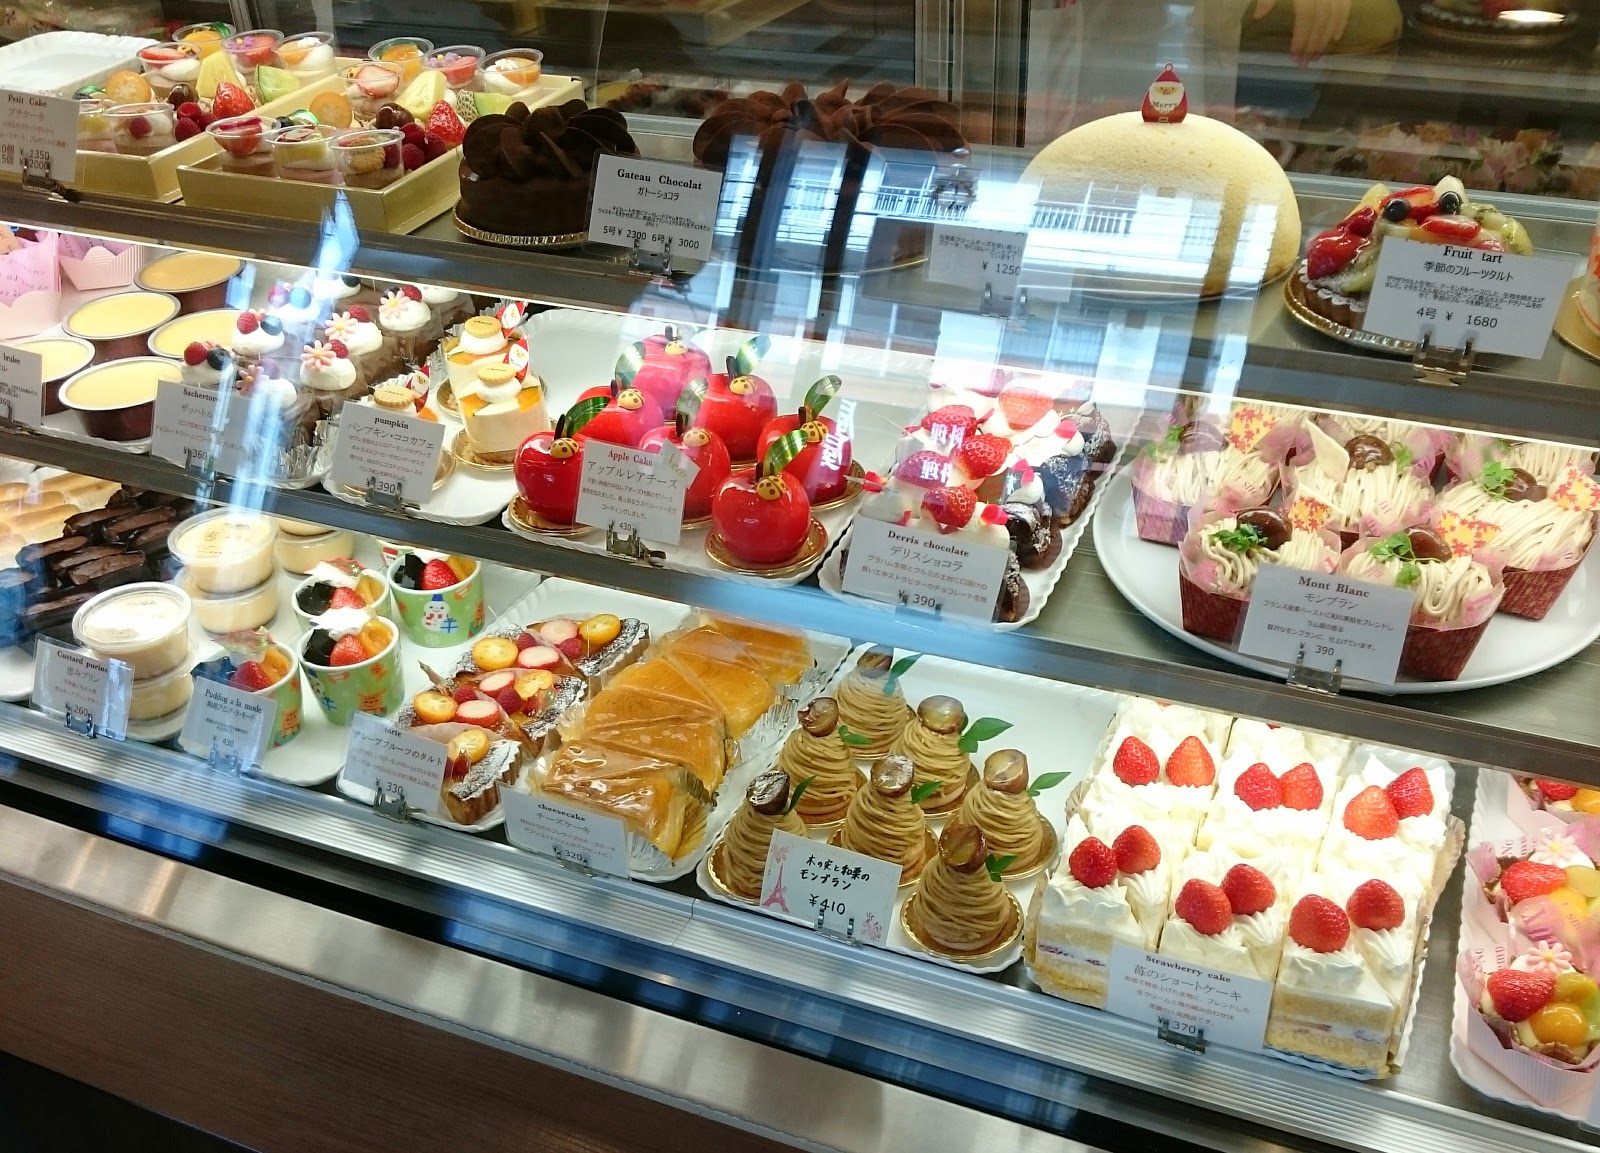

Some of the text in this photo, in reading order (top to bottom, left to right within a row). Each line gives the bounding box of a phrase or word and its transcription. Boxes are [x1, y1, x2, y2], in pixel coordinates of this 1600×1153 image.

[8, 94, 47, 107] Petit Cake
[30, 149, 50, 161] 1350
[617, 168, 702, 190] Gateau Chocolat
[637, 187, 680, 201] ガトーショコラ
[626, 229, 647, 241] 2300
[678, 238, 700, 250] 3000
[1443, 245, 1503, 264] Fruit tart
[982, 261, 1020, 275] ¥ 1250
[1423, 260, 1513, 282] 季節のフルーツタルト
[1416, 307, 1498, 329] 4号 ¥ 1680
[183, 388, 219, 403] Sachertor
[374, 417, 409, 430] pumpkin
[192, 448, 208, 460] 360
[608, 449, 653, 466] Apple Cake
[377, 480, 396, 493] 390
[618, 522, 632, 532] 430
[887, 530, 970, 558] Derris chocolate
[890, 545, 963, 572] デリスショコラ
[1298, 575, 1370, 598] Mont Blanc
[912, 593, 936, 608] 390
[1304, 593, 1359, 610] モンブラン
[57, 650, 84, 665] Custard
[1299, 642, 1335, 656] ¥ 390
[66, 666, 101, 683] 恵みプリン
[205, 688, 229, 704] Pudding
[235, 698, 242, 707] la
[244, 703, 262, 713] mode
[73, 704, 88, 717] 260
[222, 738, 235, 747] 430
[386, 781, 404, 795] 330
[537, 803, 586, 821] cheesecake
[536, 812, 591, 834] チーズケーキ
[564, 849, 583, 861] 320
[806, 854, 870, 881] 木の実と和栗の
[800, 869, 852, 890] モンブラン
[1145, 954, 1231, 983] Strawberry cake
[1134, 964, 1242, 1001] 苺のショートケーキ
[1173, 1020, 1196, 1034] 370
